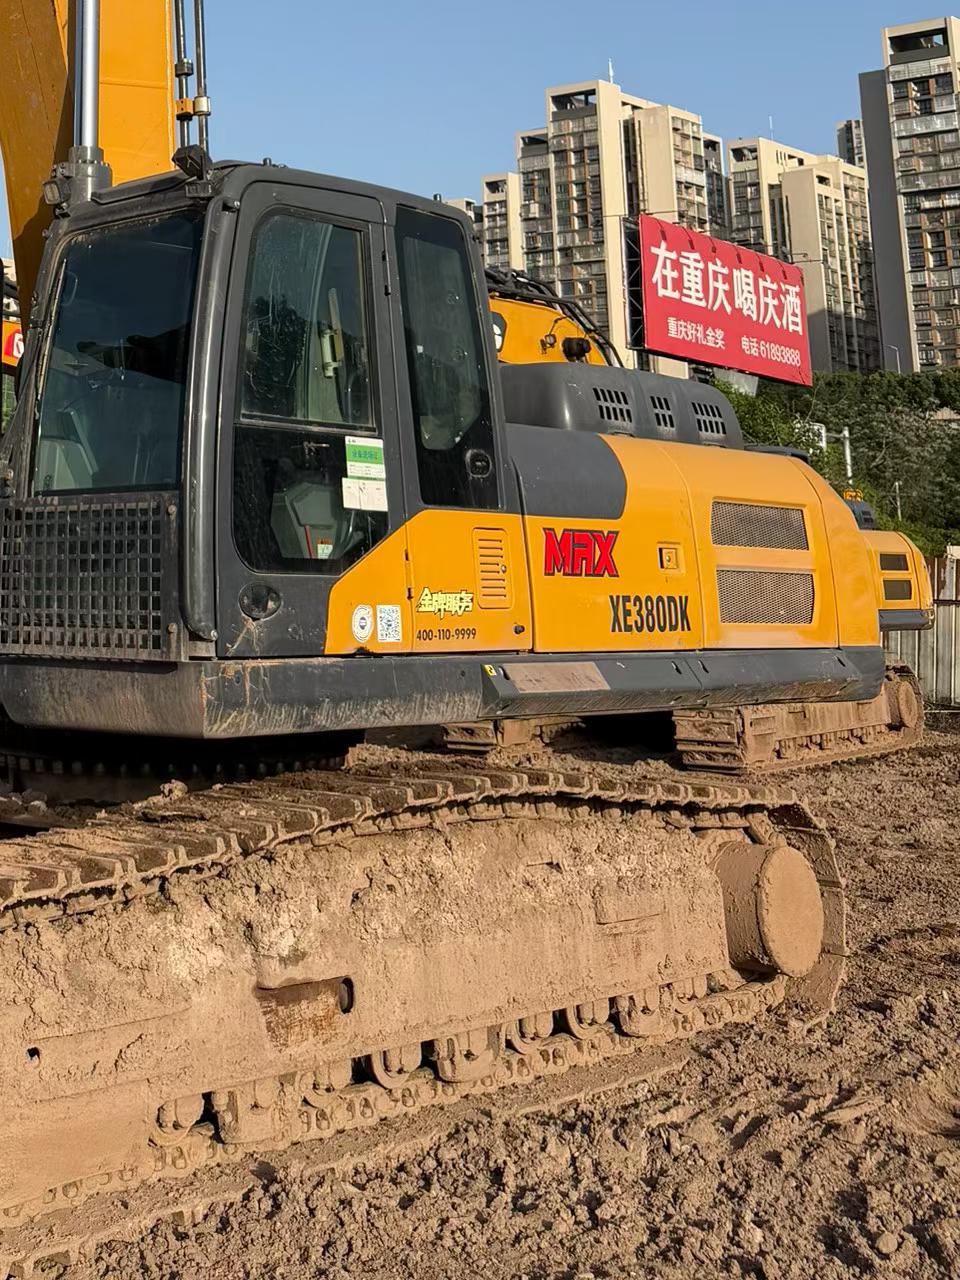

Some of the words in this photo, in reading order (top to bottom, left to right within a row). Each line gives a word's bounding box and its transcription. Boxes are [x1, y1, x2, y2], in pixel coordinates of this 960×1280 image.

[650, 239, 804, 336] 在重庆喝庆酒
[667, 316, 726, 350] 重庆好礼金奖
[543, 527, 620, 578] MAX
[416, 586, 474, 620] 金牌服务
[609, 594, 692, 634] XE380DK
[416, 627, 477, 642] 400-110-9999
